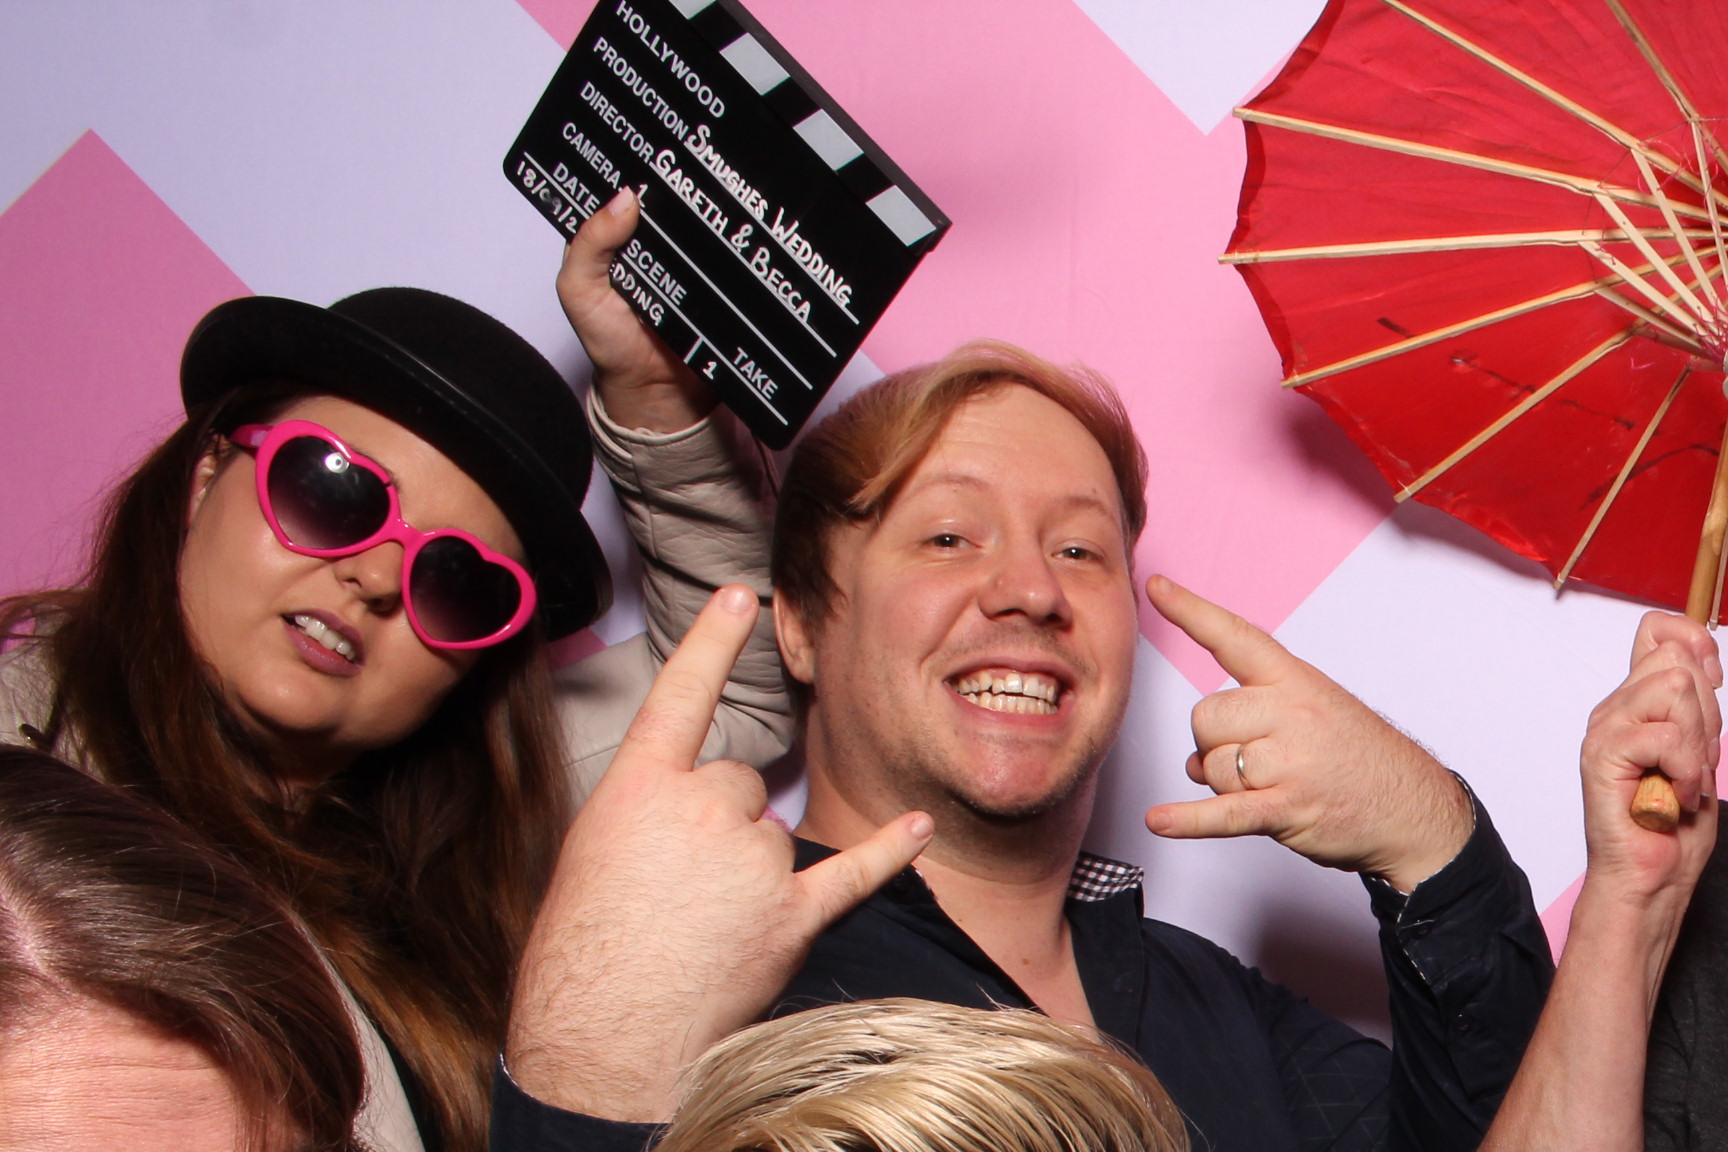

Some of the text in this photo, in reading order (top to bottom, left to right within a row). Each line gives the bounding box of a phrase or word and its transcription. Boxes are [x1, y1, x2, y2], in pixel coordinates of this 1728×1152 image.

[593, 36, 689, 141] PRODUCTION
[616, 0, 725, 118] HOLLYWOOD
[562, 122, 621, 189] CAMERA
[580, 81, 654, 163] DIRECTOR
[517, 161, 577, 234] 18/09/2
[553, 162, 600, 215] DATE
[656, 149, 811, 323] GARETH & BECCA
[771, 206, 852, 307] WEDDING
[609, 262, 665, 326] DDING
[626, 239, 687, 306] SCENE
[702, 360, 717, 380] 1
[732, 346, 779, 400] TAKE
